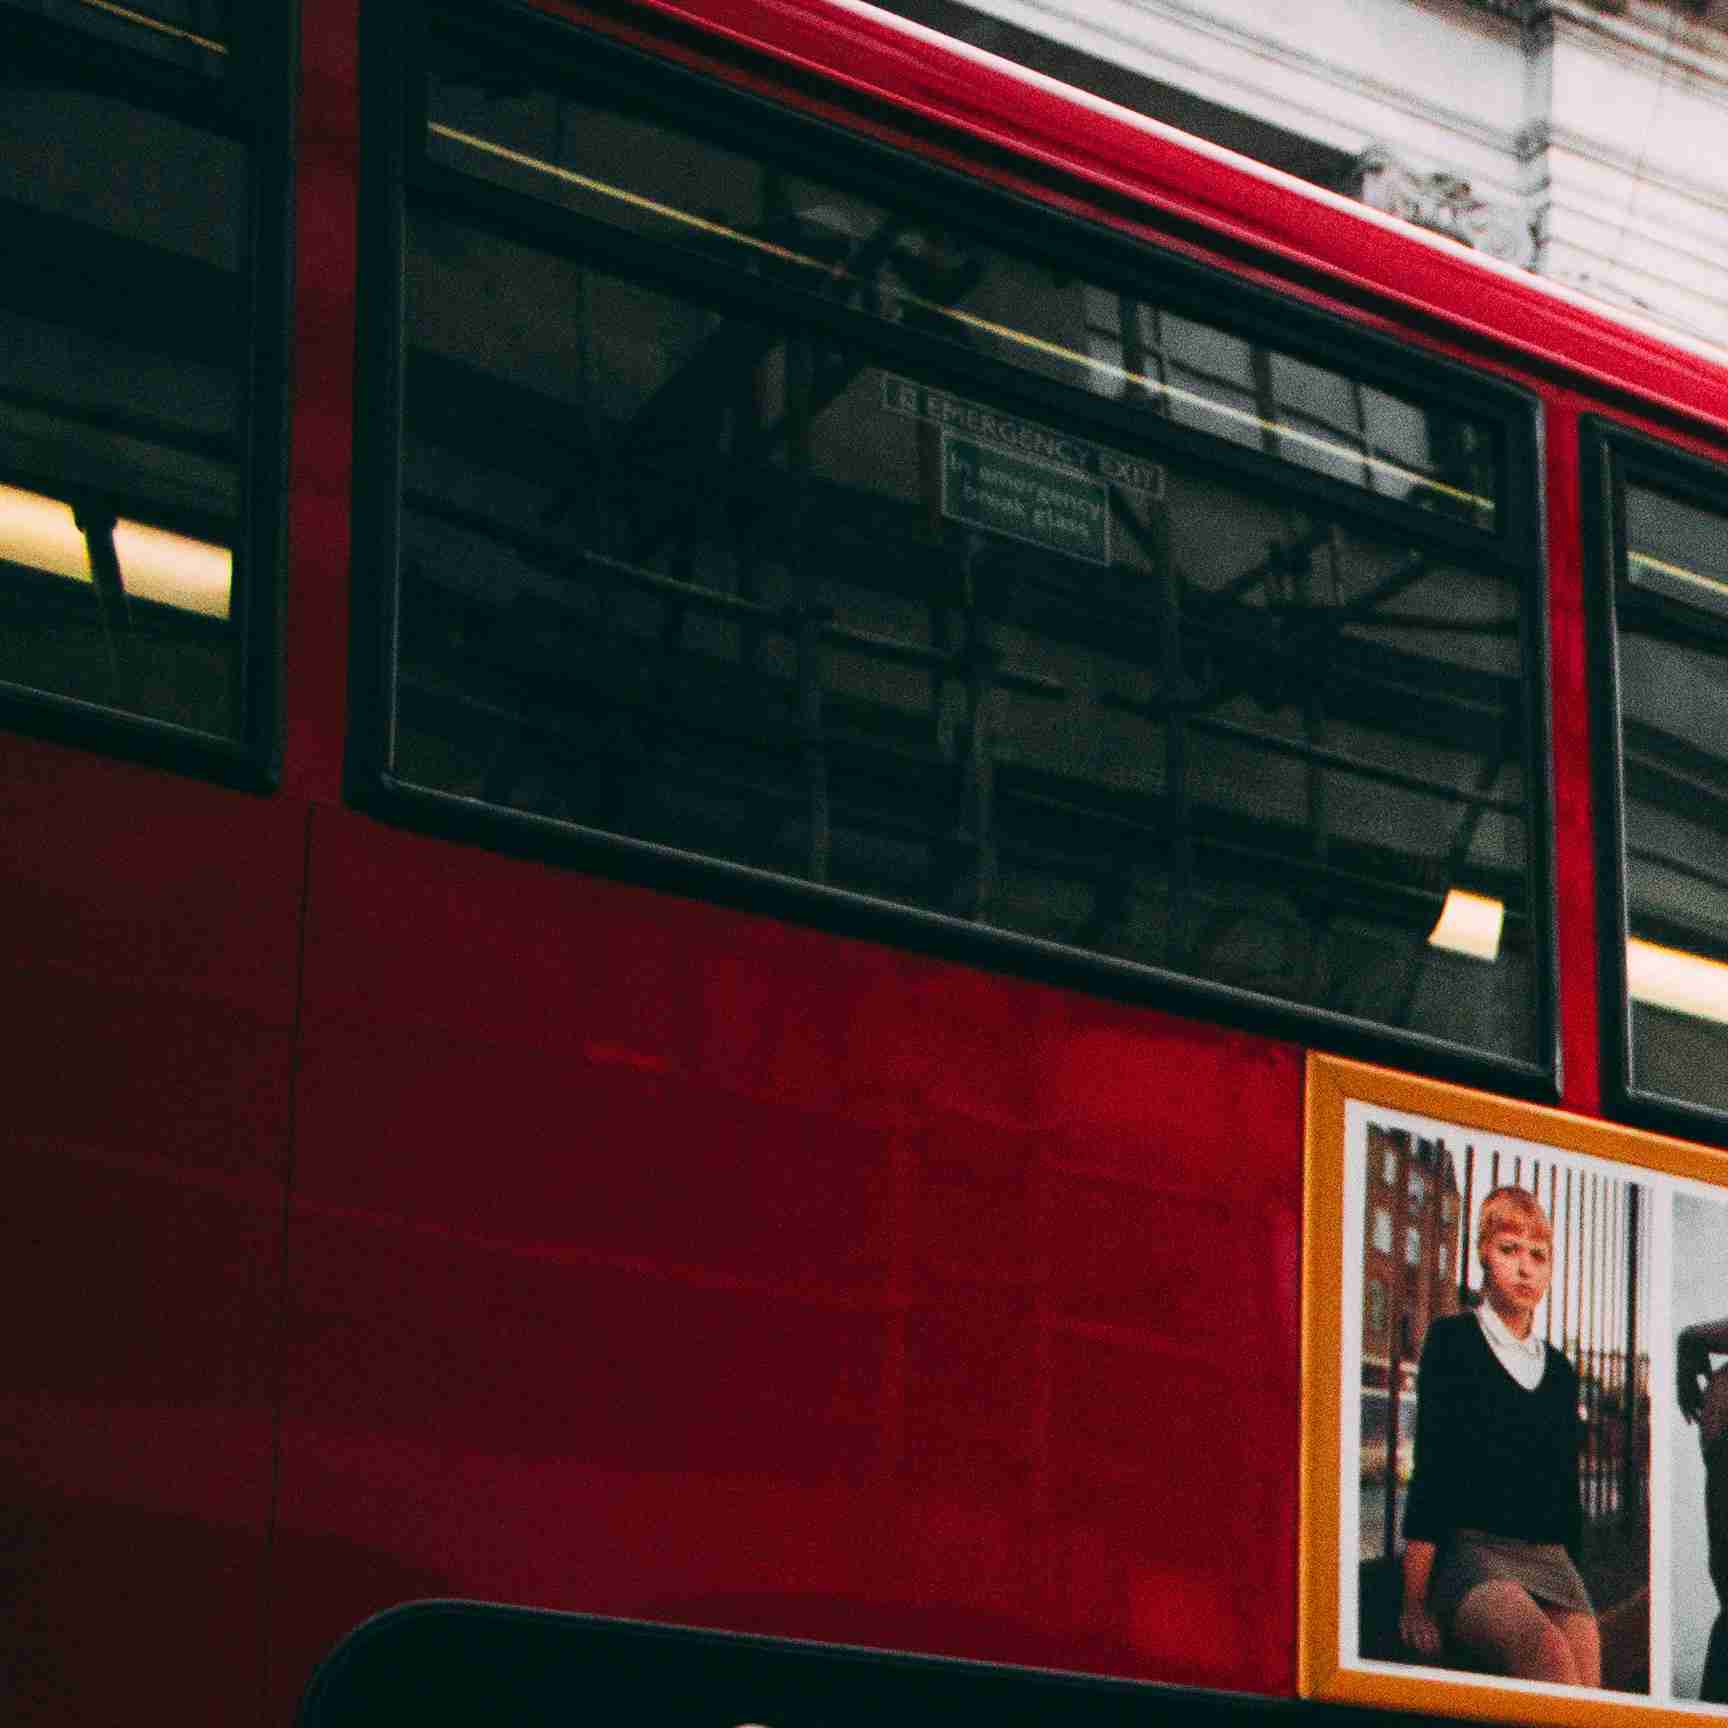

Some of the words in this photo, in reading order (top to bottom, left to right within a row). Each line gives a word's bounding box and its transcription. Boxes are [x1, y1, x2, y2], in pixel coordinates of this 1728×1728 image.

[927, 398, 1090, 464] EMERGENCY
[1099, 449, 1155, 490] EXIT
[978, 465, 1103, 521] emergency
